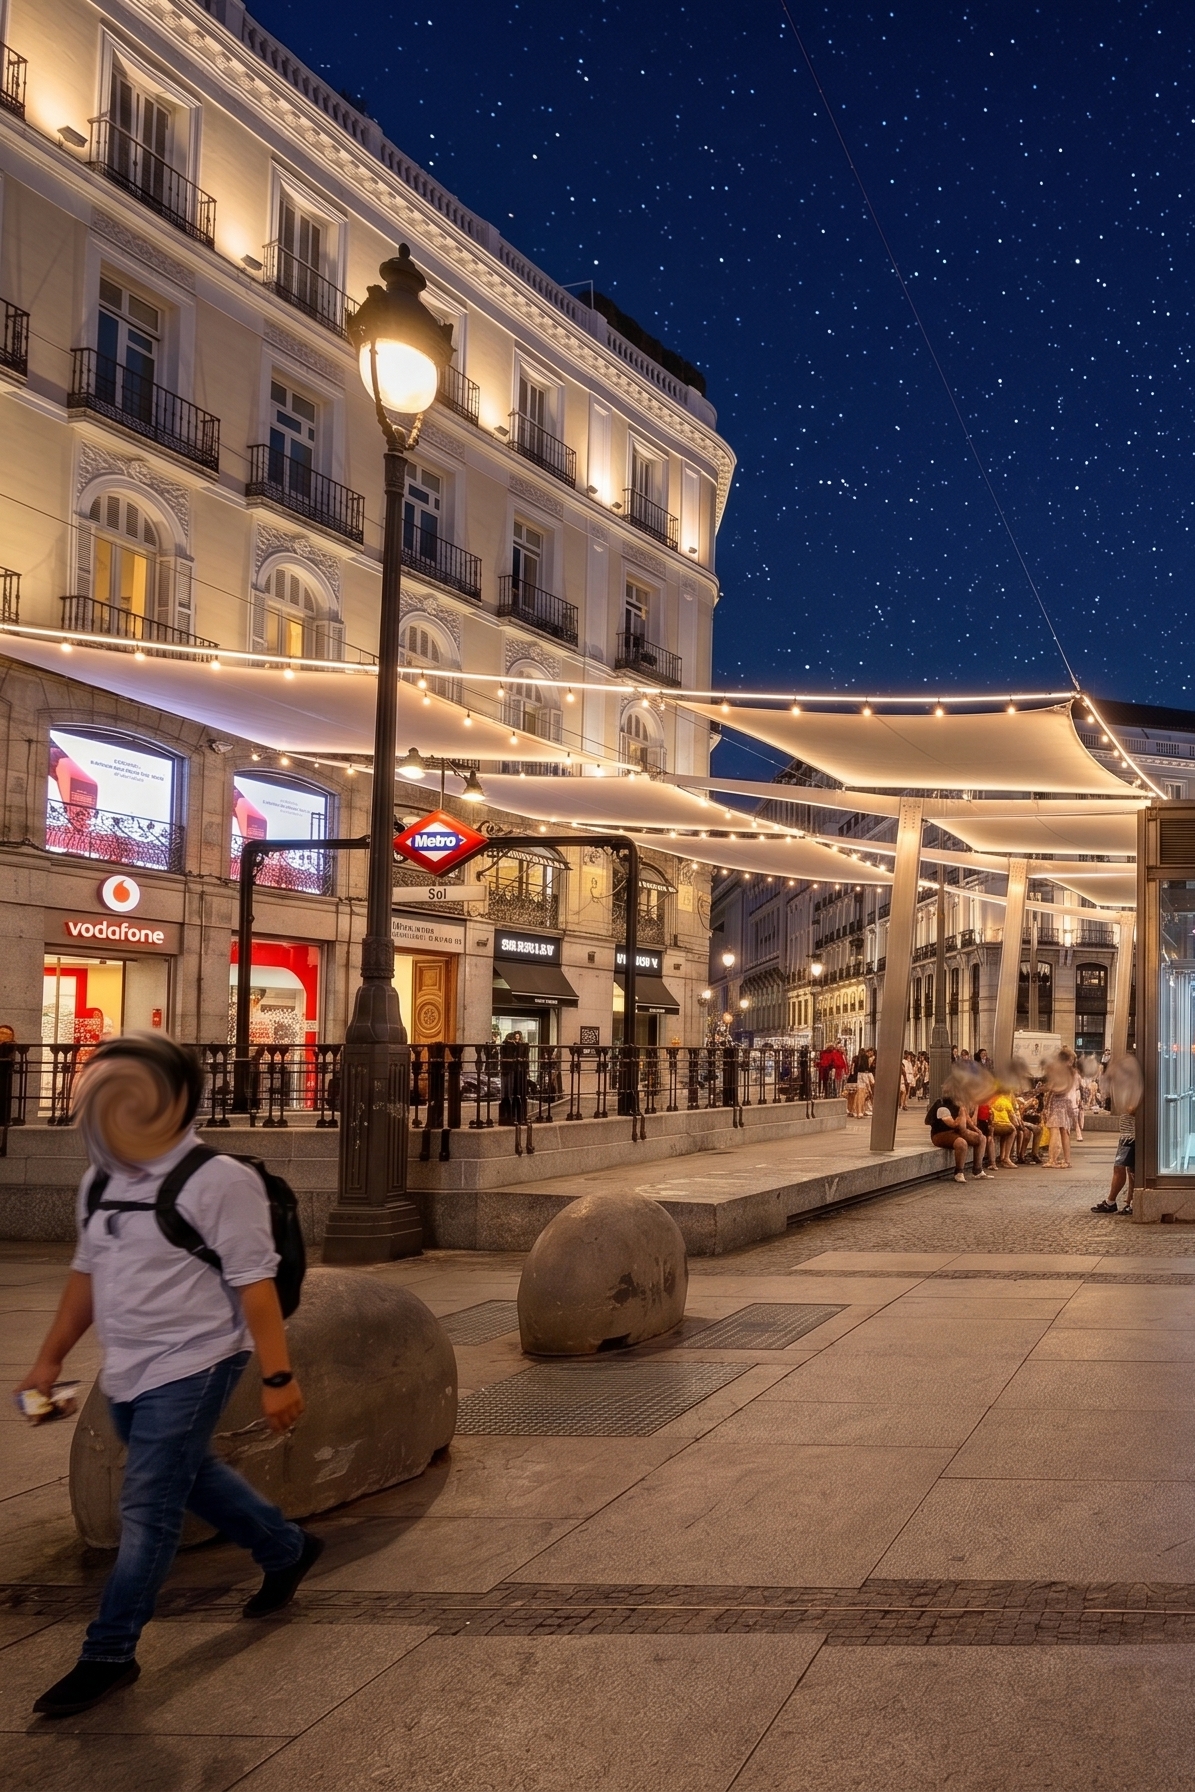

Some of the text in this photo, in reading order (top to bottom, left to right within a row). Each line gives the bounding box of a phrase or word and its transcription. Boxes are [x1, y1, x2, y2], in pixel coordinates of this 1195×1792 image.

[414, 834, 457, 848] Metro
[428, 887, 447, 901] Sol
[66, 921, 165, 944] vodafone
